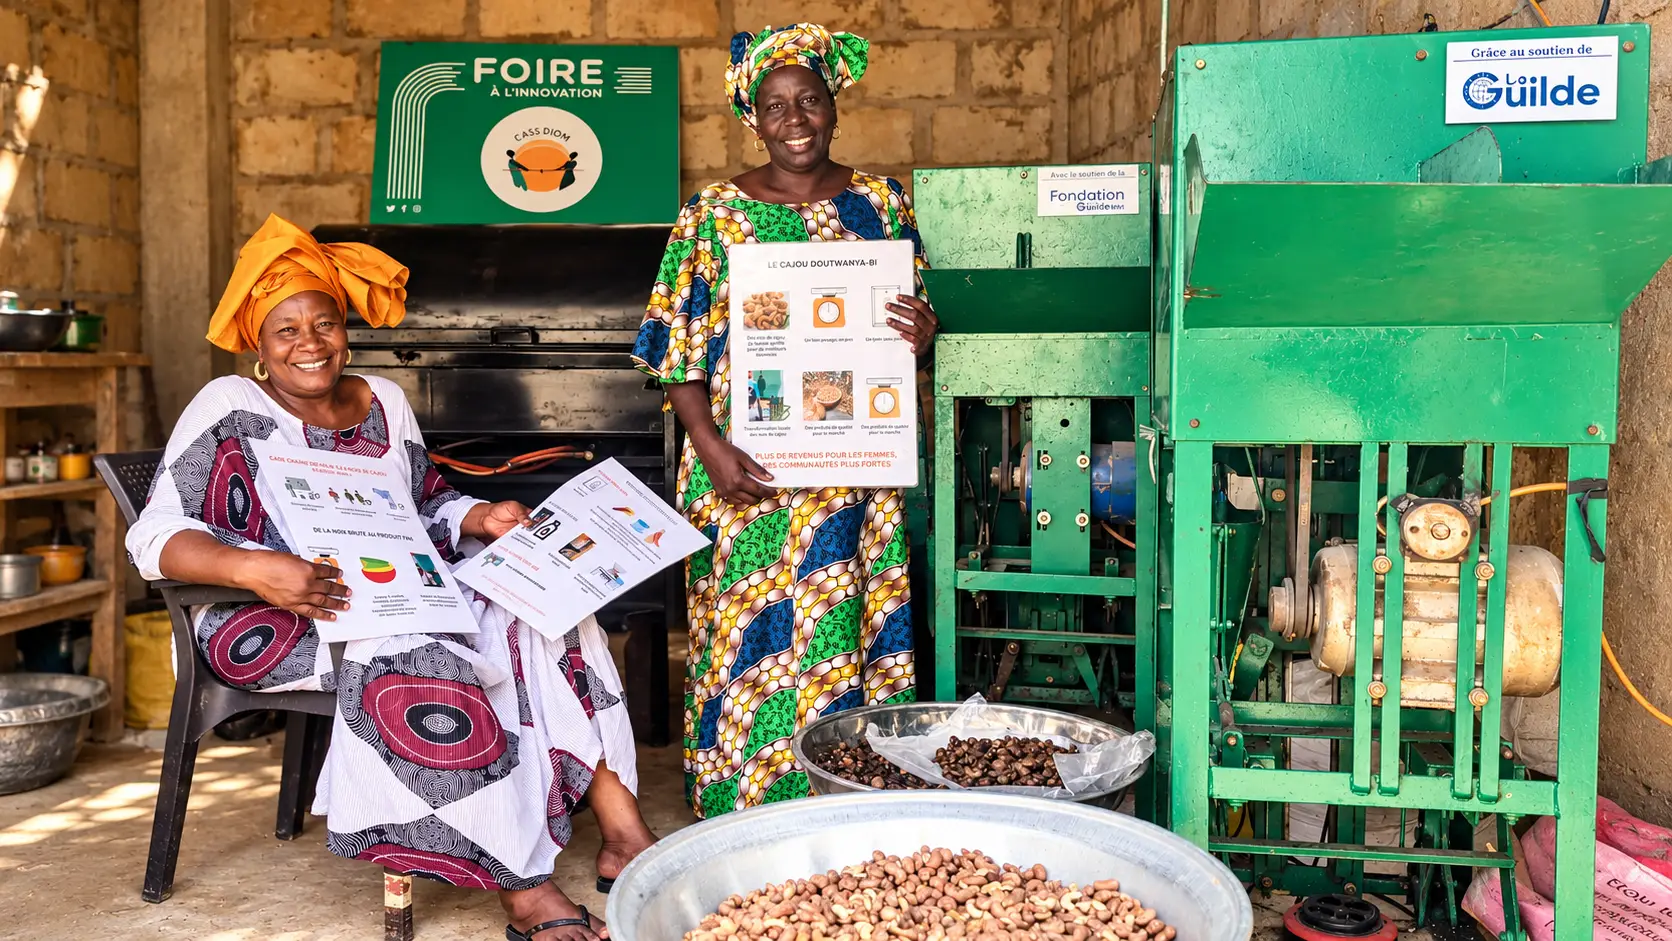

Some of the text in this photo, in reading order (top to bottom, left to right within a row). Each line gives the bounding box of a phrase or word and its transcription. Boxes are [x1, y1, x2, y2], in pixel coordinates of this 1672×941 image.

[1510, 48, 1525, 57] au
[1528, 46, 1574, 56] soutien
[1577, 44, 1593, 54] de
[474, 57, 604, 85] FOIRE
[490, 84, 602, 98] À L'INNOVATION
[514, 127, 571, 142] CASS DIOM
[1070, 170, 1076, 178] le
[1078, 170, 1106, 178] soutien
[1050, 188, 1125, 202] Fondation
[768, 259, 878, 269] LE CAJOU DOUTWANYA-BI
[755, 452, 775, 460] PLUS
[863, 451, 898, 459] FEMMES,
[861, 460, 892, 468] FORTES
